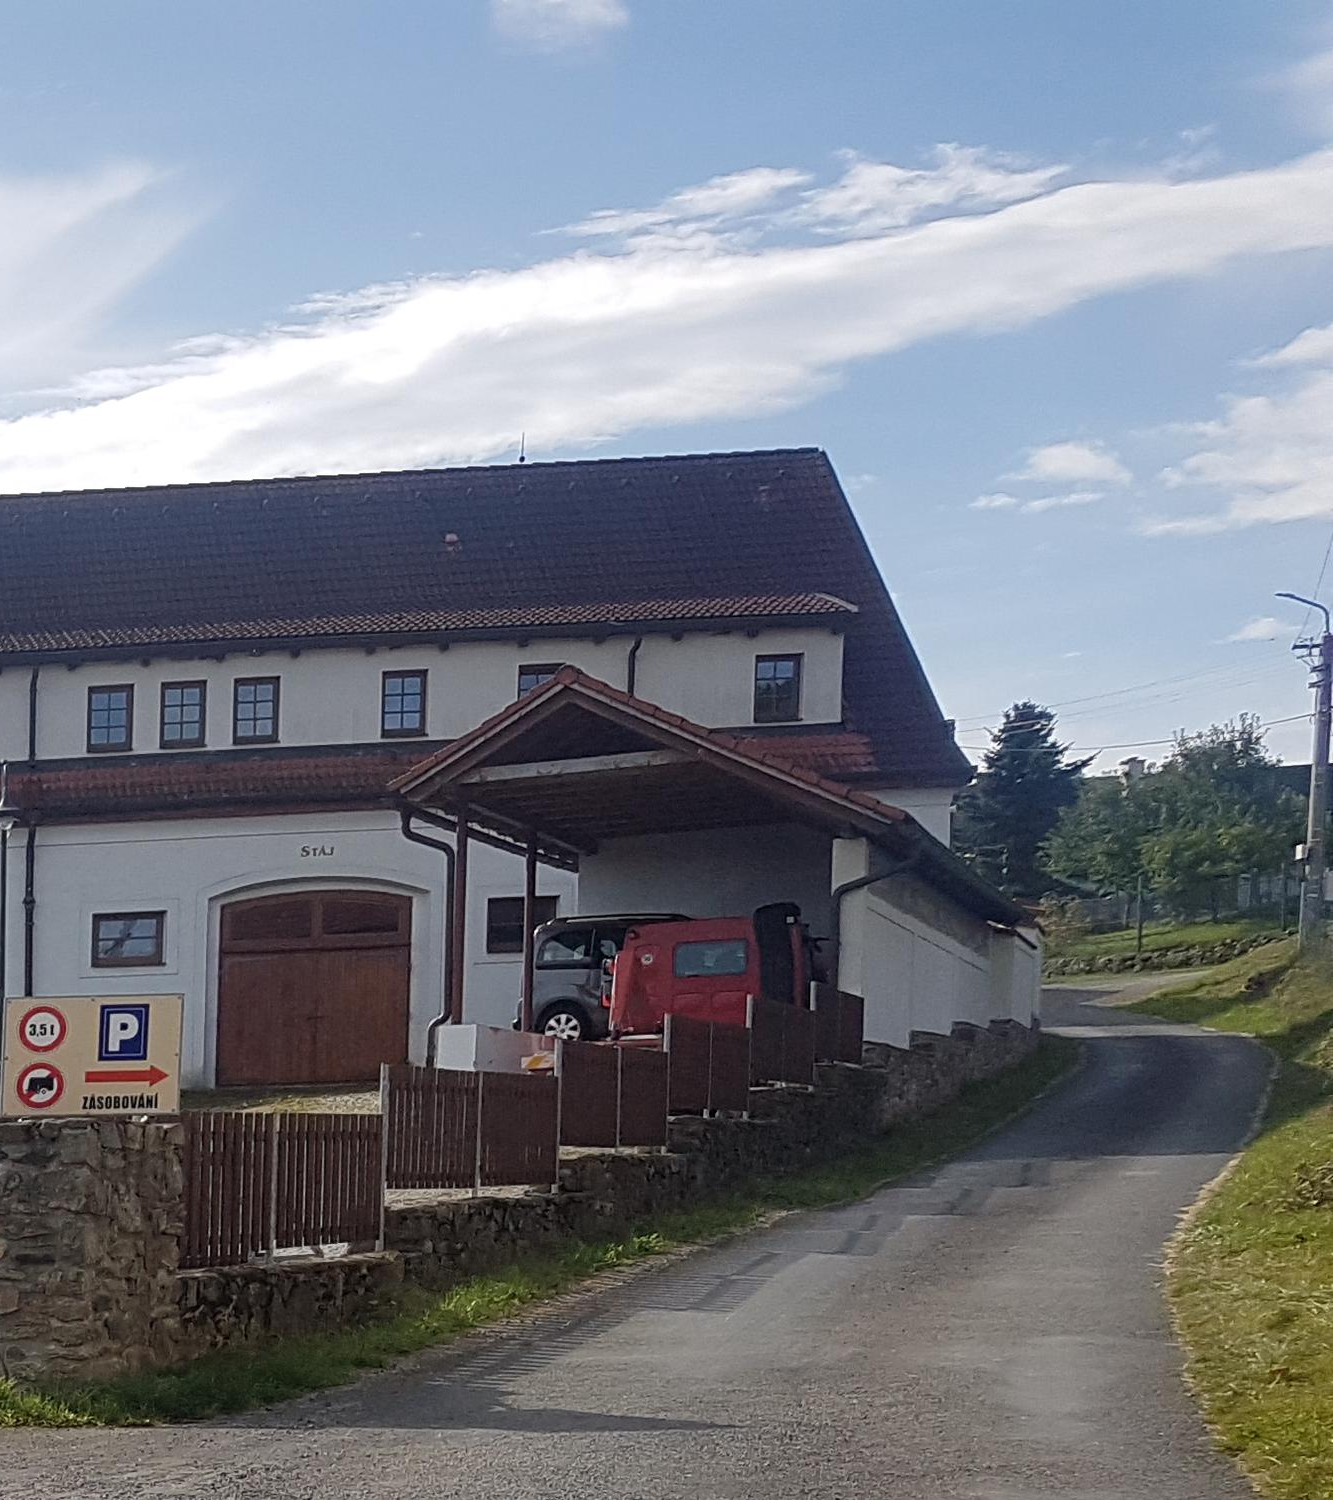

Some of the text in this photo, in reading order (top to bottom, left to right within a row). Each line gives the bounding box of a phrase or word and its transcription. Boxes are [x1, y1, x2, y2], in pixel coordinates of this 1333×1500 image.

[29, 1023, 47, 1037] 3,5
[108, 1013, 139, 1052] P
[82, 1092, 158, 1110] ZÁSOBOVÁNÍ
